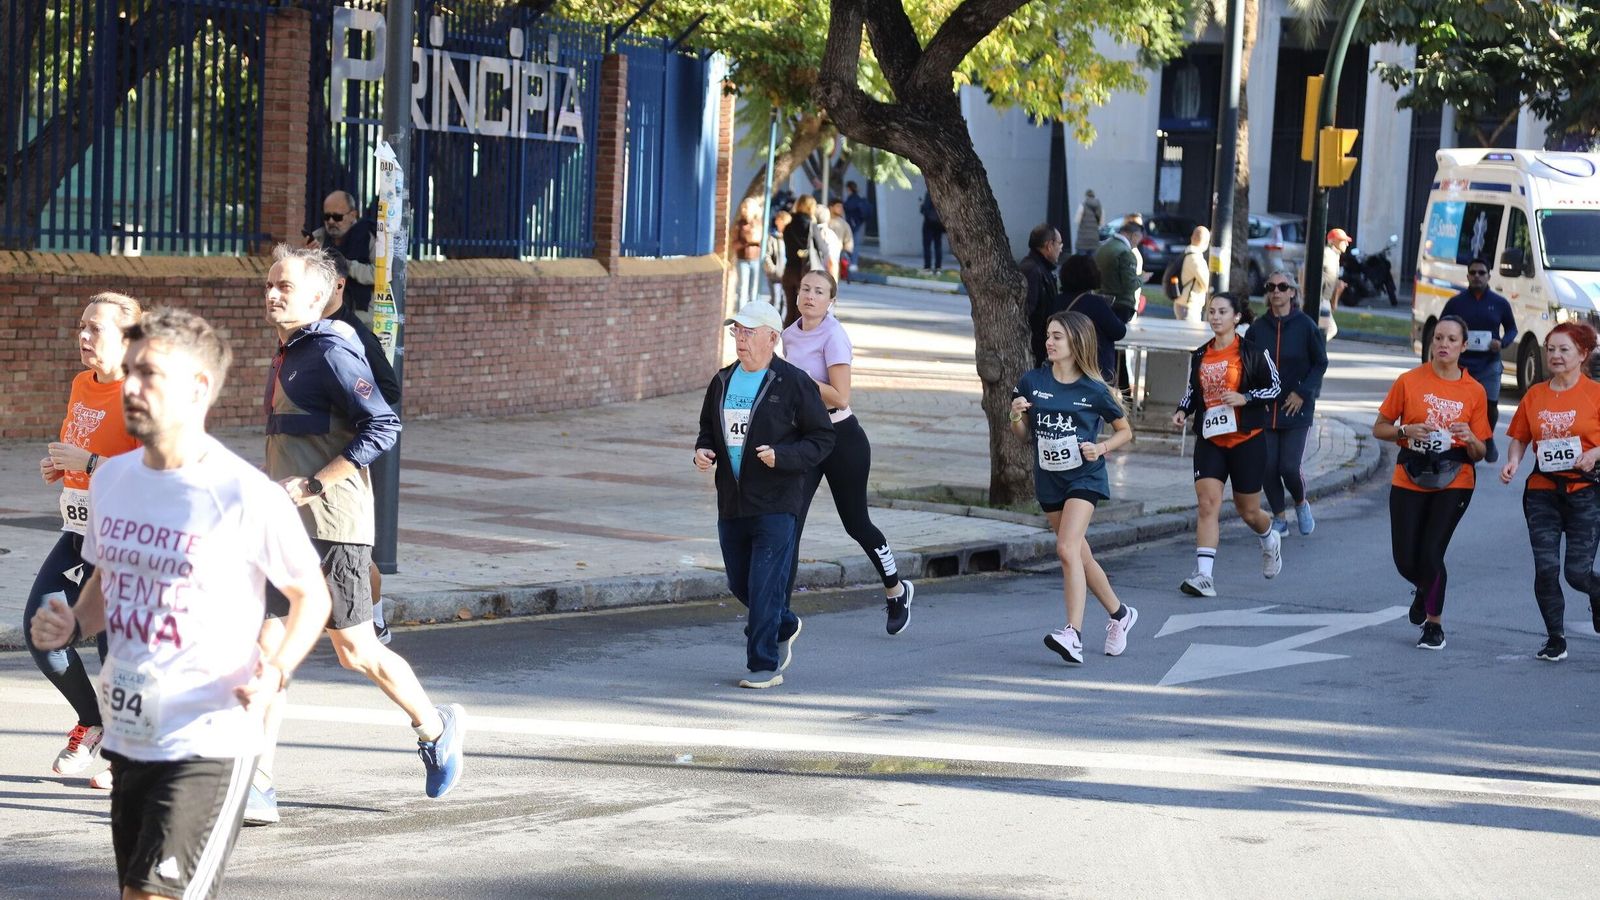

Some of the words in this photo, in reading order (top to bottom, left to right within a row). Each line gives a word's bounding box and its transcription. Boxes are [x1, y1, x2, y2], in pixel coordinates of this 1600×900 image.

[1205, 415, 1228, 429] 949
[1413, 440, 1442, 451] 852
[1043, 448, 1070, 461] 929
[1544, 449, 1574, 462] 546
[67, 504, 88, 521] 88
[100, 516, 201, 555] DEPORTE
